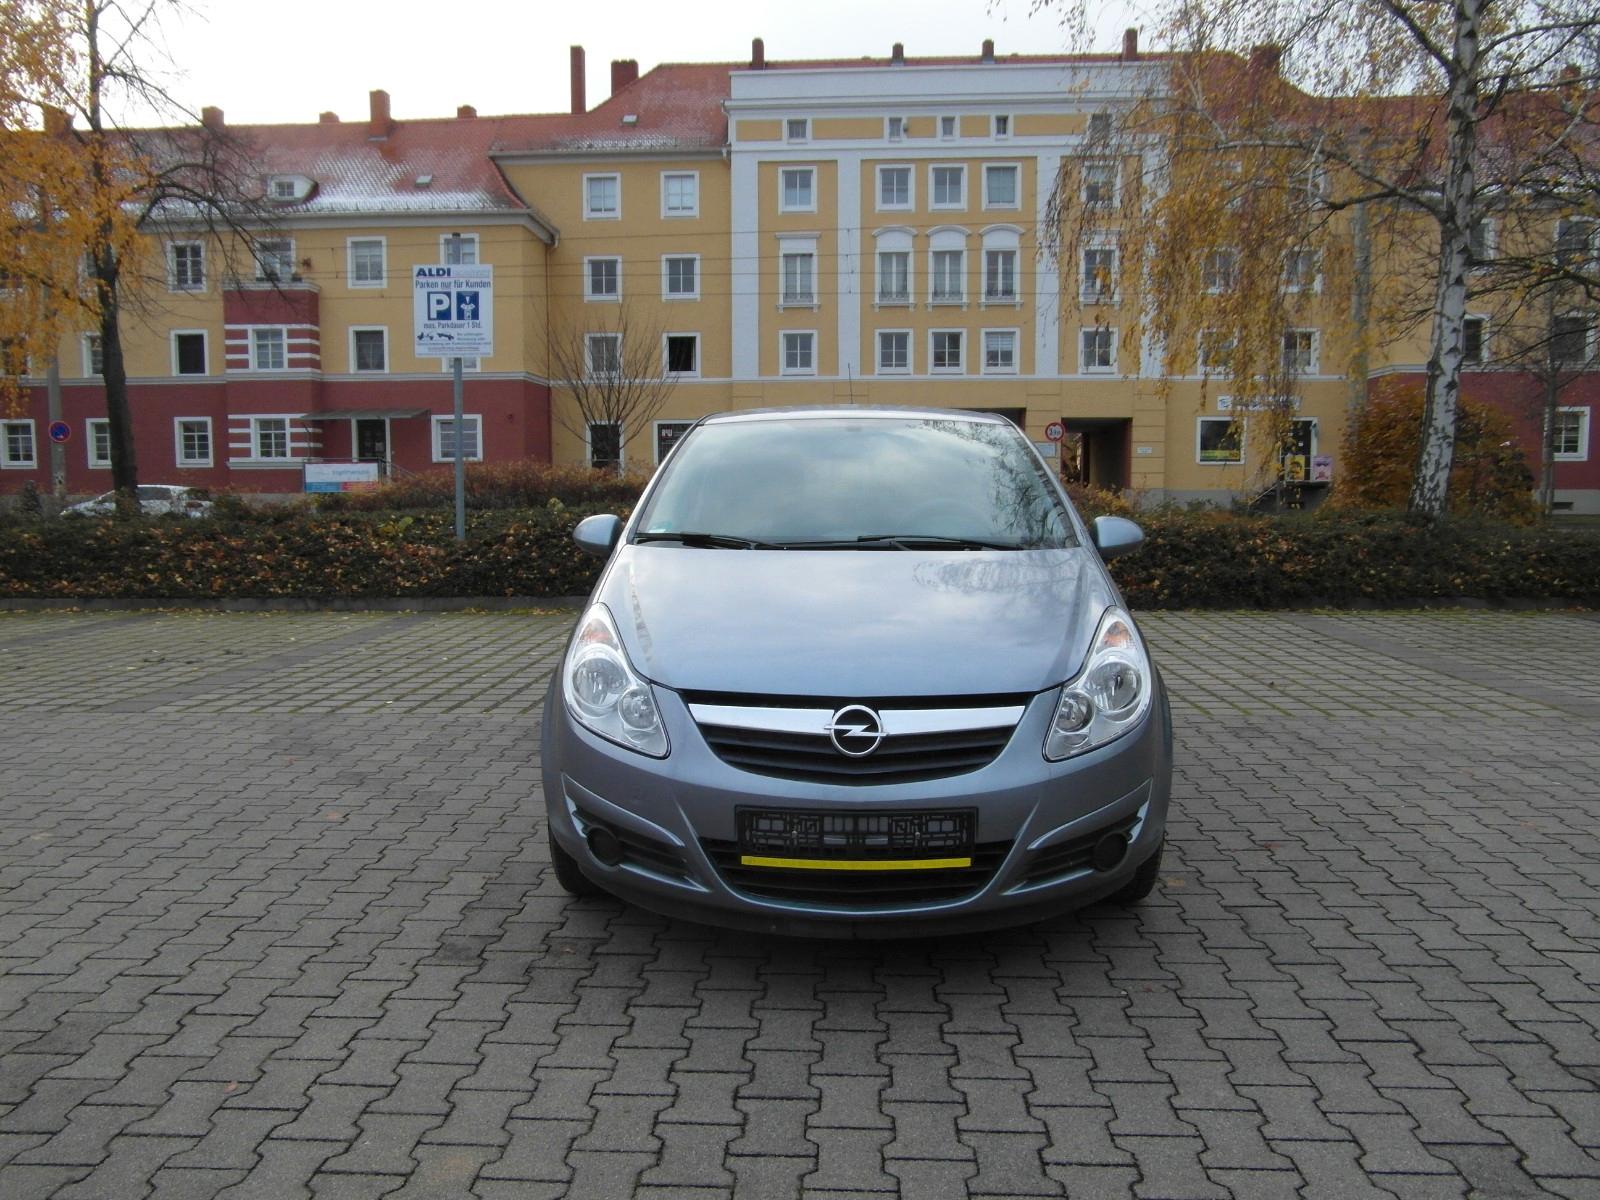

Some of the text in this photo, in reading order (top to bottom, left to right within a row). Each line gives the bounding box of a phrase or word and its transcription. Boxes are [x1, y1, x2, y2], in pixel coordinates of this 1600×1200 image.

[416, 267, 451, 277] ALDI
[415, 280, 439, 288] Parken
[454, 280, 464, 288] für
[465, 280, 491, 288] Kunden
[429, 293, 450, 319] P
[438, 321, 465, 329] Parkdauer
